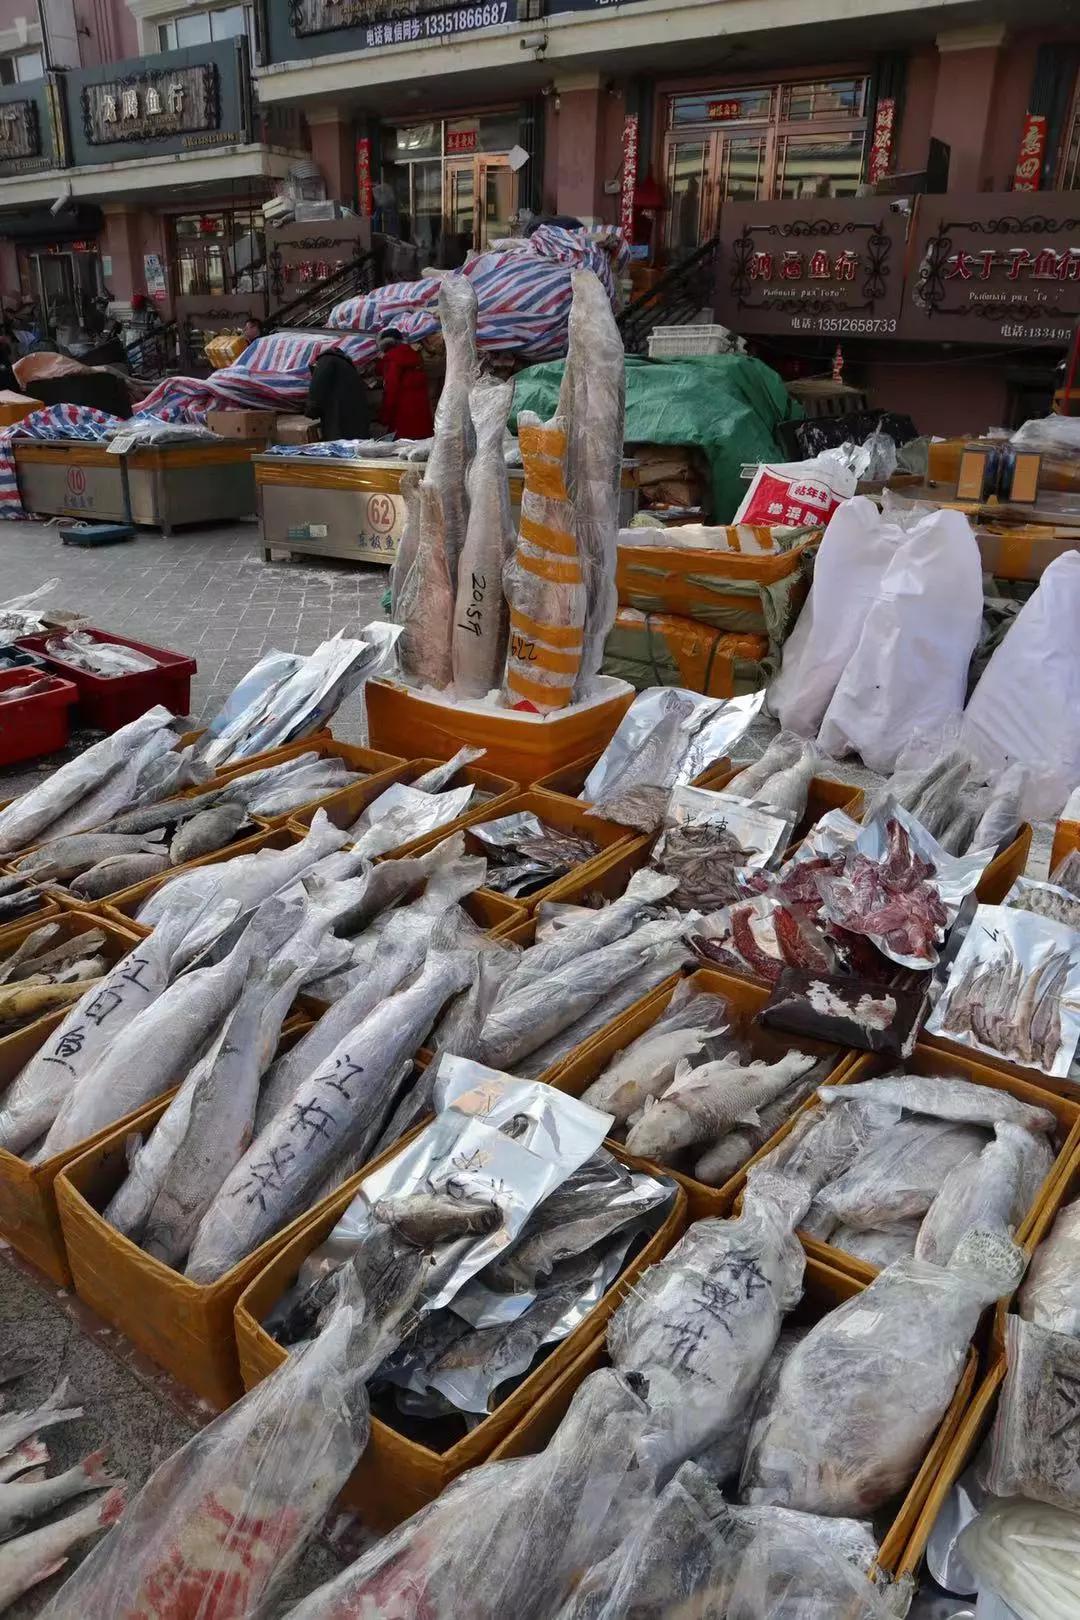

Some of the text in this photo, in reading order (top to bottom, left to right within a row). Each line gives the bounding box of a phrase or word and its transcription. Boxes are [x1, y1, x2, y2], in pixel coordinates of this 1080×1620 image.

[371, 498, 390, 524] 62
[358, 530, 401, 551] 东极鱼
